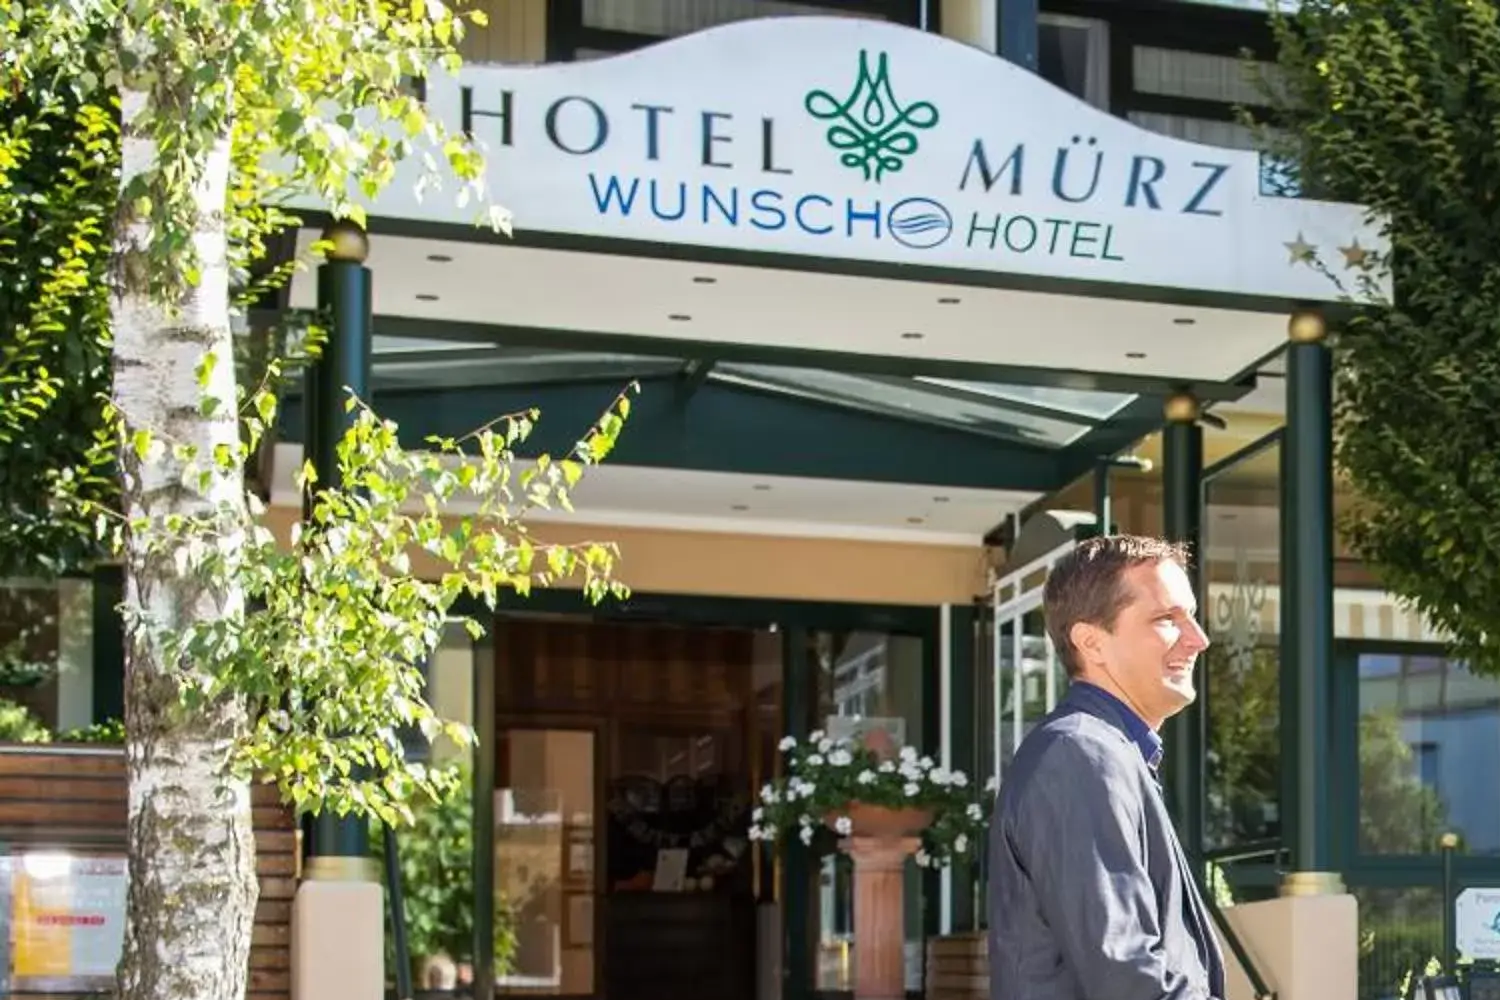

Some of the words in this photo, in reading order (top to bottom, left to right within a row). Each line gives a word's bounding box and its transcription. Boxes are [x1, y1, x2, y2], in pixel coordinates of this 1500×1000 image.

[461, 85, 793, 174] HOTEL
[958, 136, 1232, 216] MÜRZ
[588, 172, 882, 239] WUNSCH
[966, 212, 1125, 262] HOTEL
